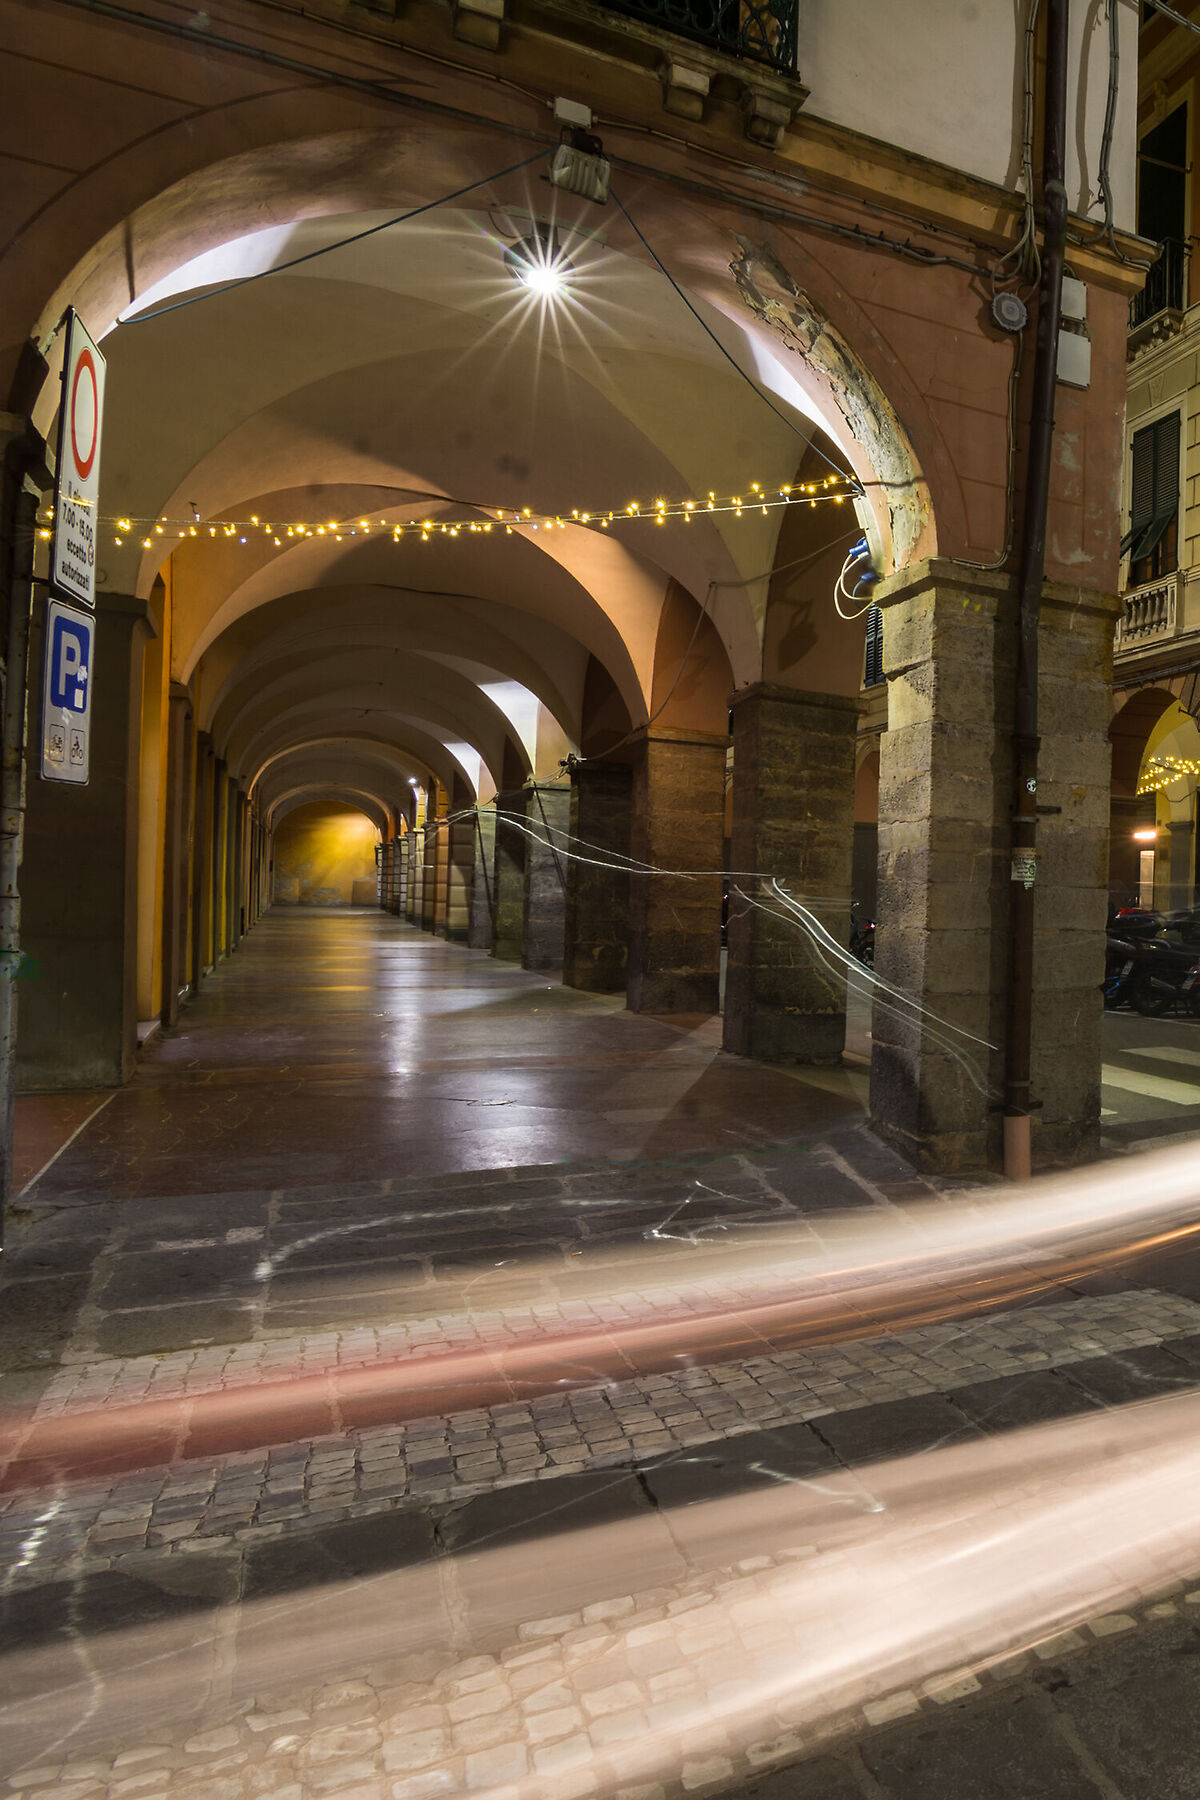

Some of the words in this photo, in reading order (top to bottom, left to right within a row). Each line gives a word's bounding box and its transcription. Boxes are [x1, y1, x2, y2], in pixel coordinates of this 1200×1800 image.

[67, 538, 87, 564] eccetto
[62, 560, 90, 592] autorizzati
[58, 630, 82, 696] P
